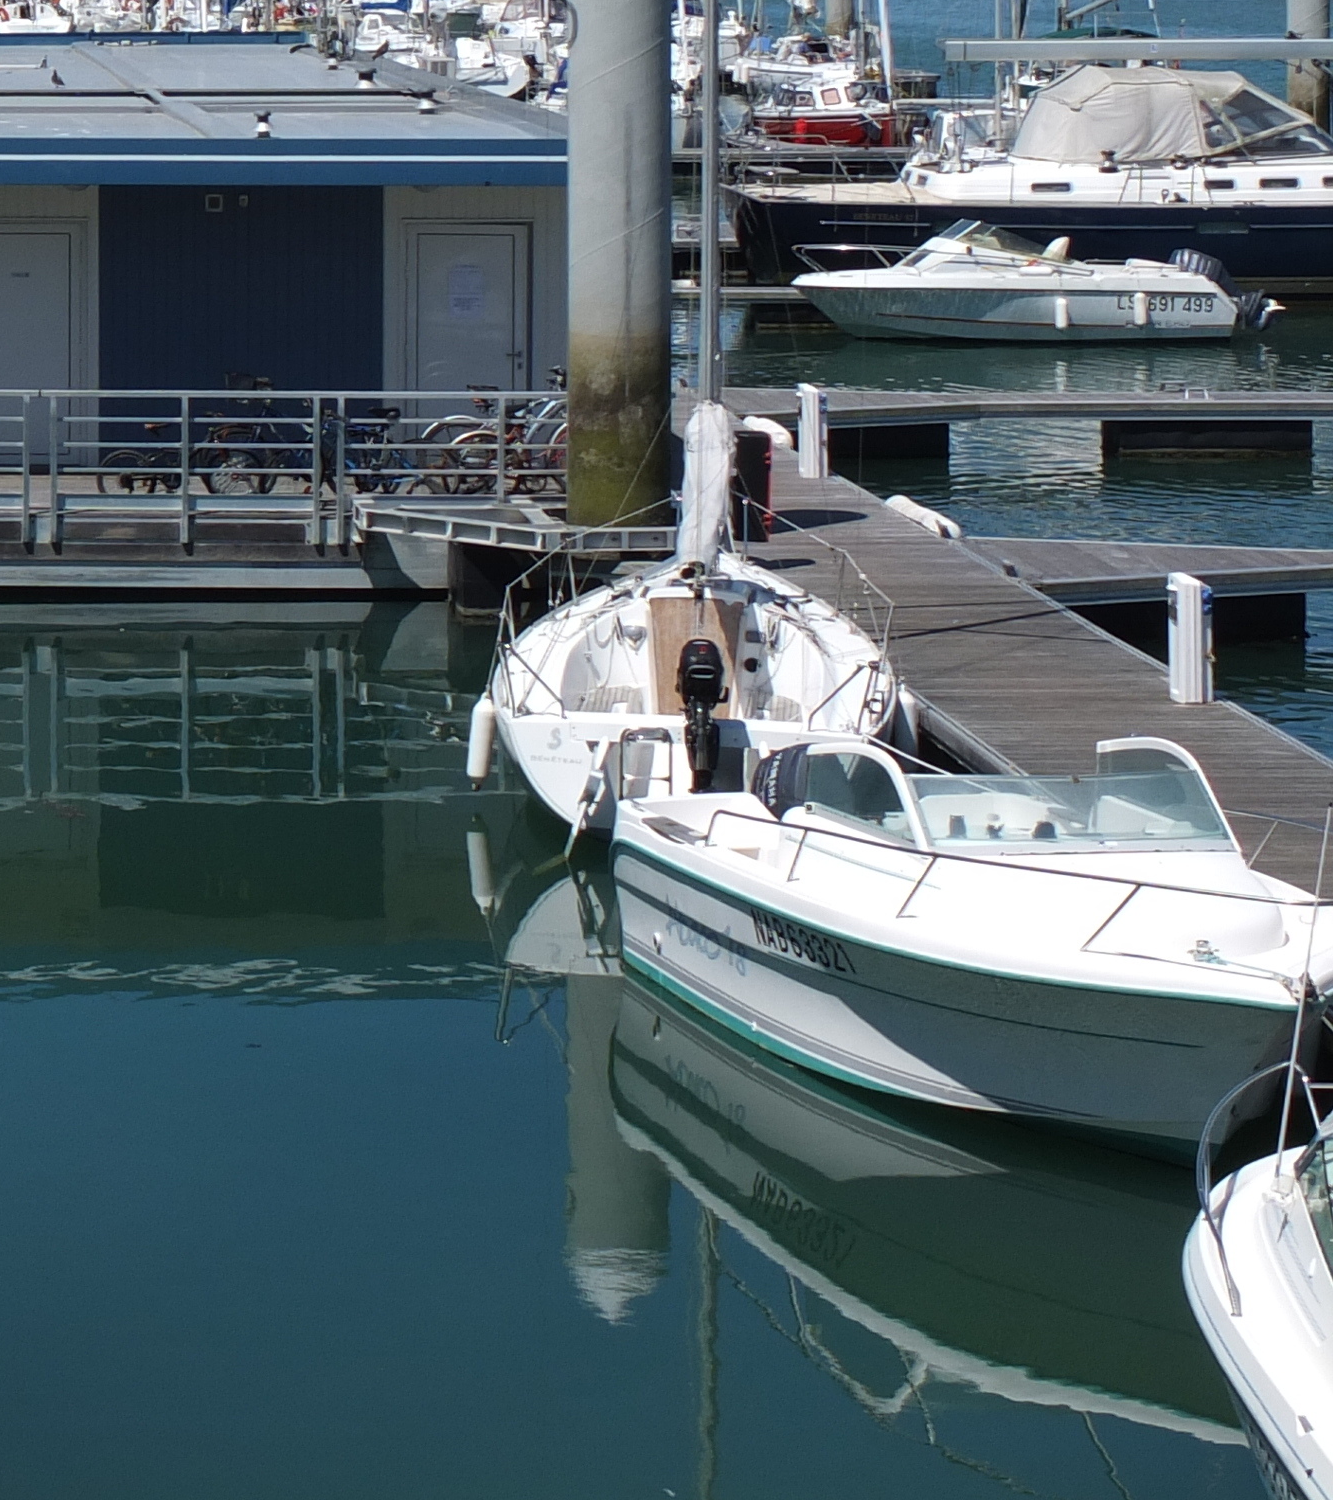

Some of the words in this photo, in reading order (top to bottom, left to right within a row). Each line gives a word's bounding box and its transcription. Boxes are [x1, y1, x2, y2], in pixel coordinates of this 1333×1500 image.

[1148, 295, 1175, 312] 691
[1182, 296, 1214, 313] 499
[766, 752, 783, 807] YAMAHA
[750, 906, 857, 975] NAB63321
